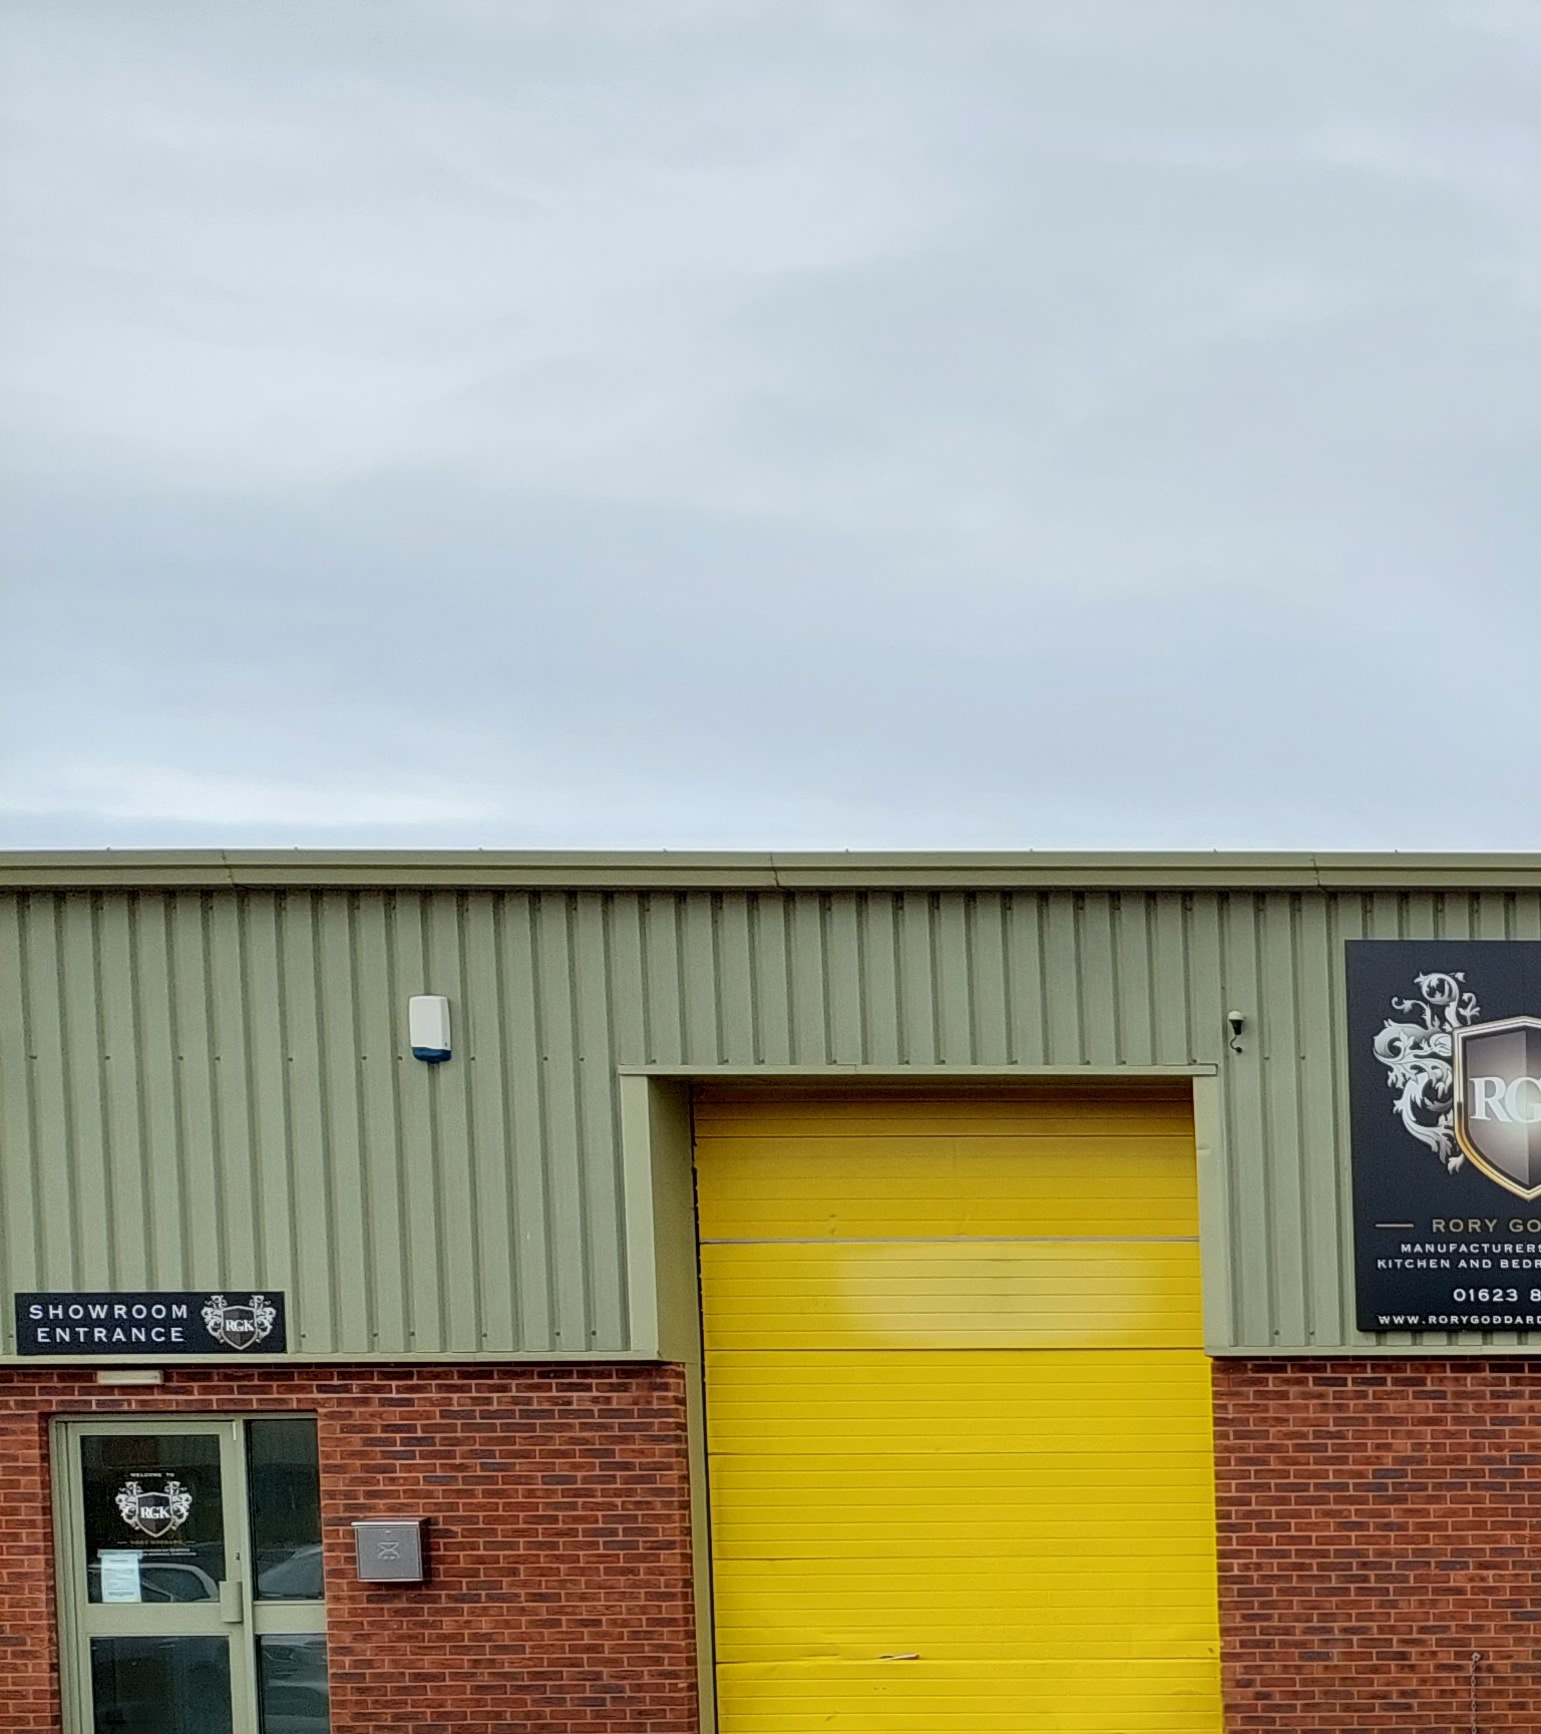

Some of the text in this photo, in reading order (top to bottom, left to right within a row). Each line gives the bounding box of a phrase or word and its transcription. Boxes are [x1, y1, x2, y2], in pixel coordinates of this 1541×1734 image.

[1432, 1219, 1498, 1233] RORY
[1377, 1259, 1450, 1270] KITCHEN
[1458, 1258, 1492, 1268] AND
[1453, 1289, 1518, 1302] 01623
[29, 1304, 188, 1320] SHOWROOM
[226, 1320, 254, 1332] RGK
[37, 1328, 184, 1342] ENTRANCE
[140, 1506, 170, 1518] RGK
